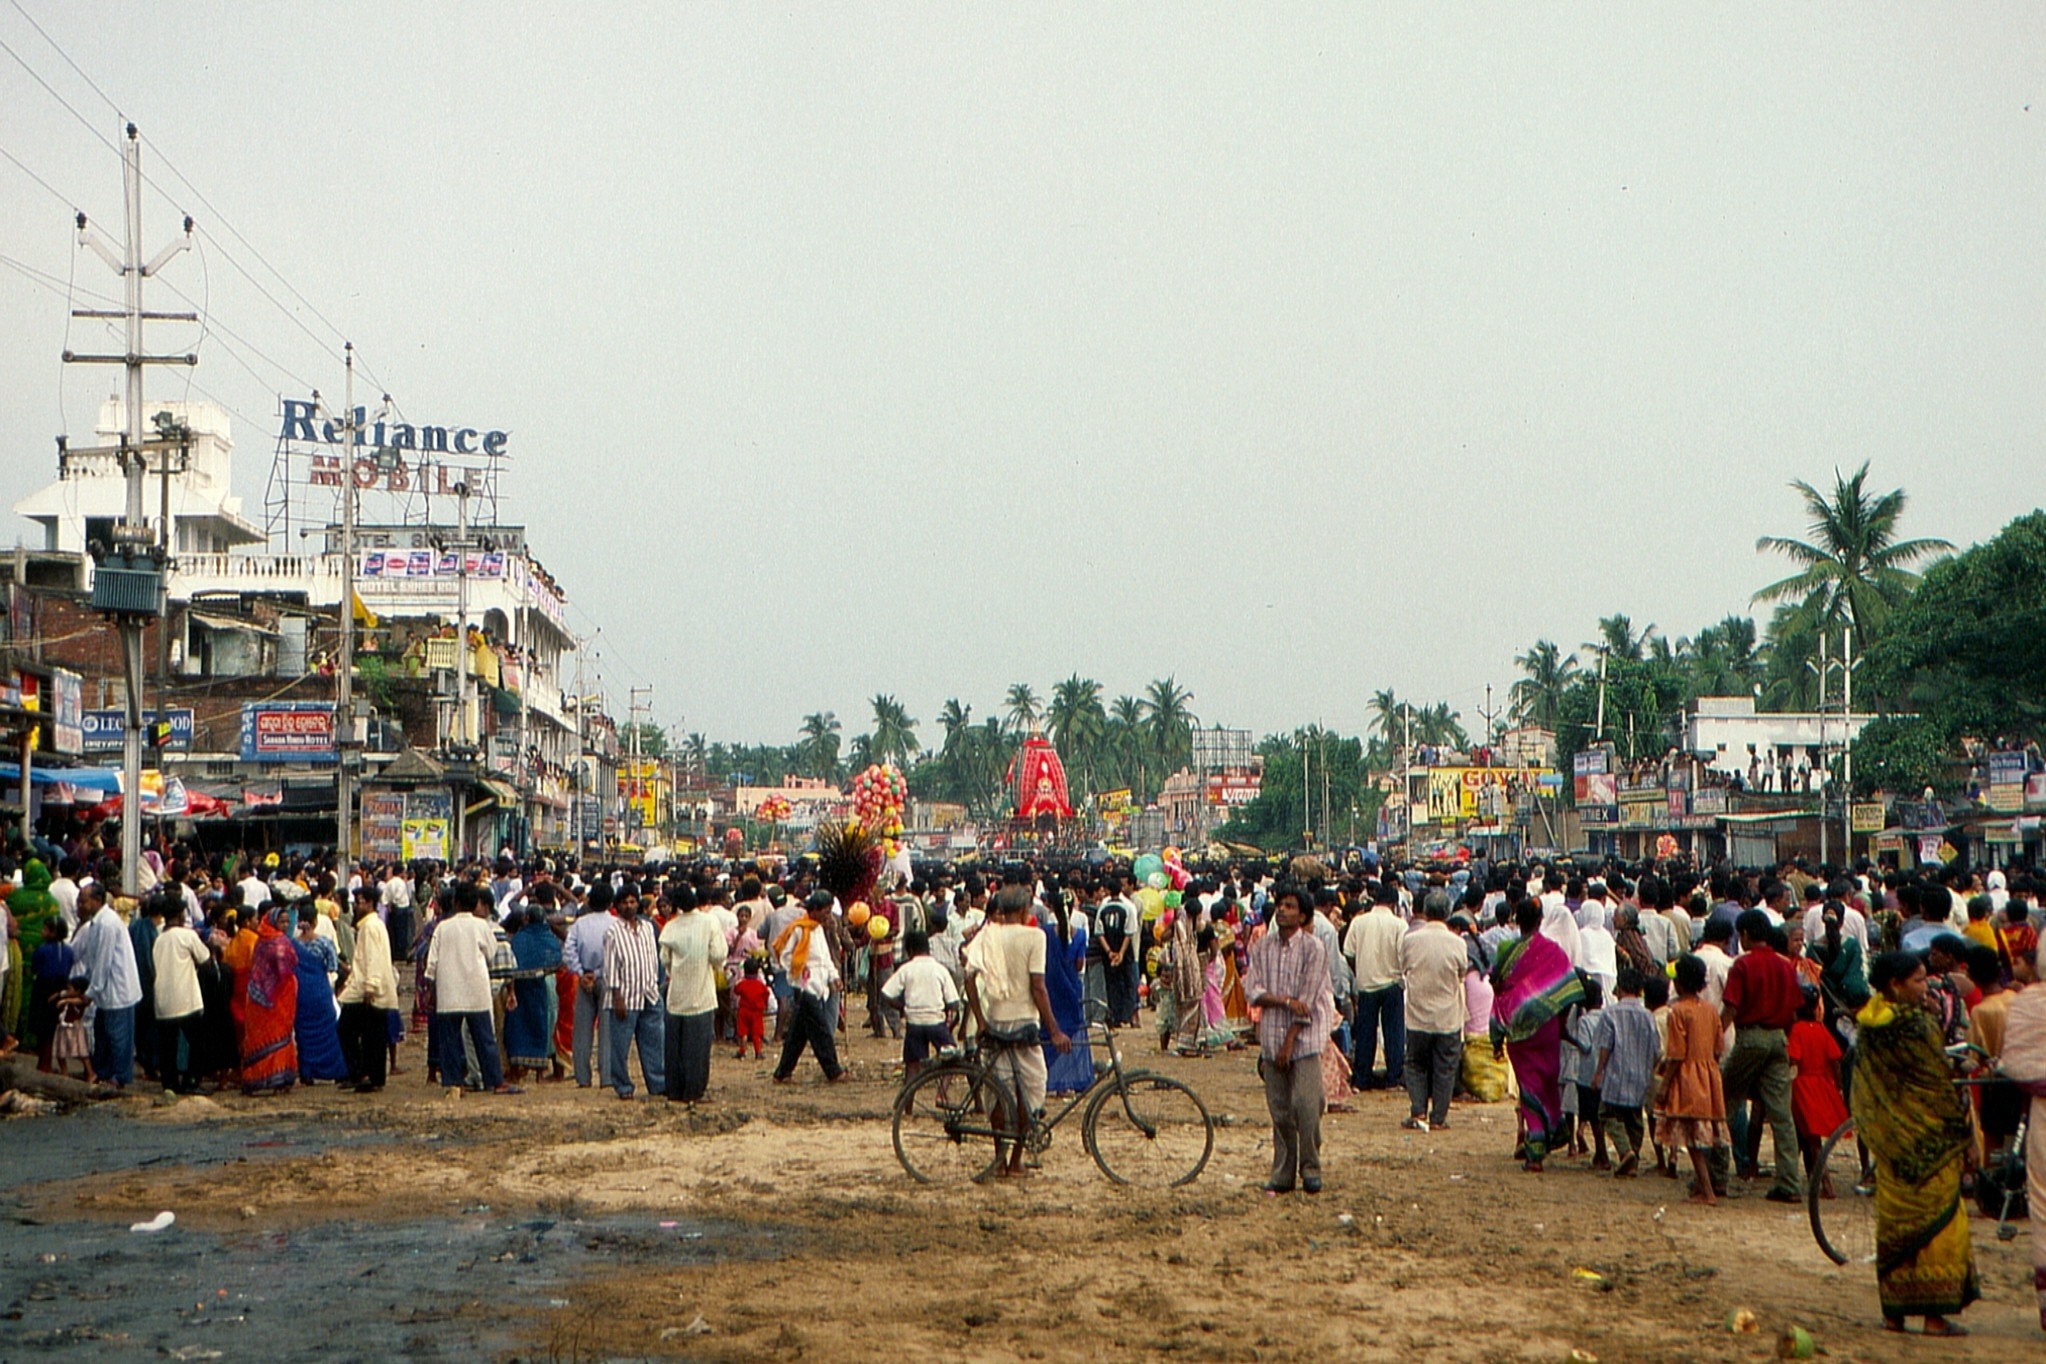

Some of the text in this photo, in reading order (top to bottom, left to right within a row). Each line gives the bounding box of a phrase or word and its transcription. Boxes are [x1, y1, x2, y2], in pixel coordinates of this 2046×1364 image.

[283, 400, 508, 456] Reliance
[310, 455, 484, 496] MOBILE
[333, 532, 398, 549] HOTEL
[305, 733, 328, 745] HOTEL
